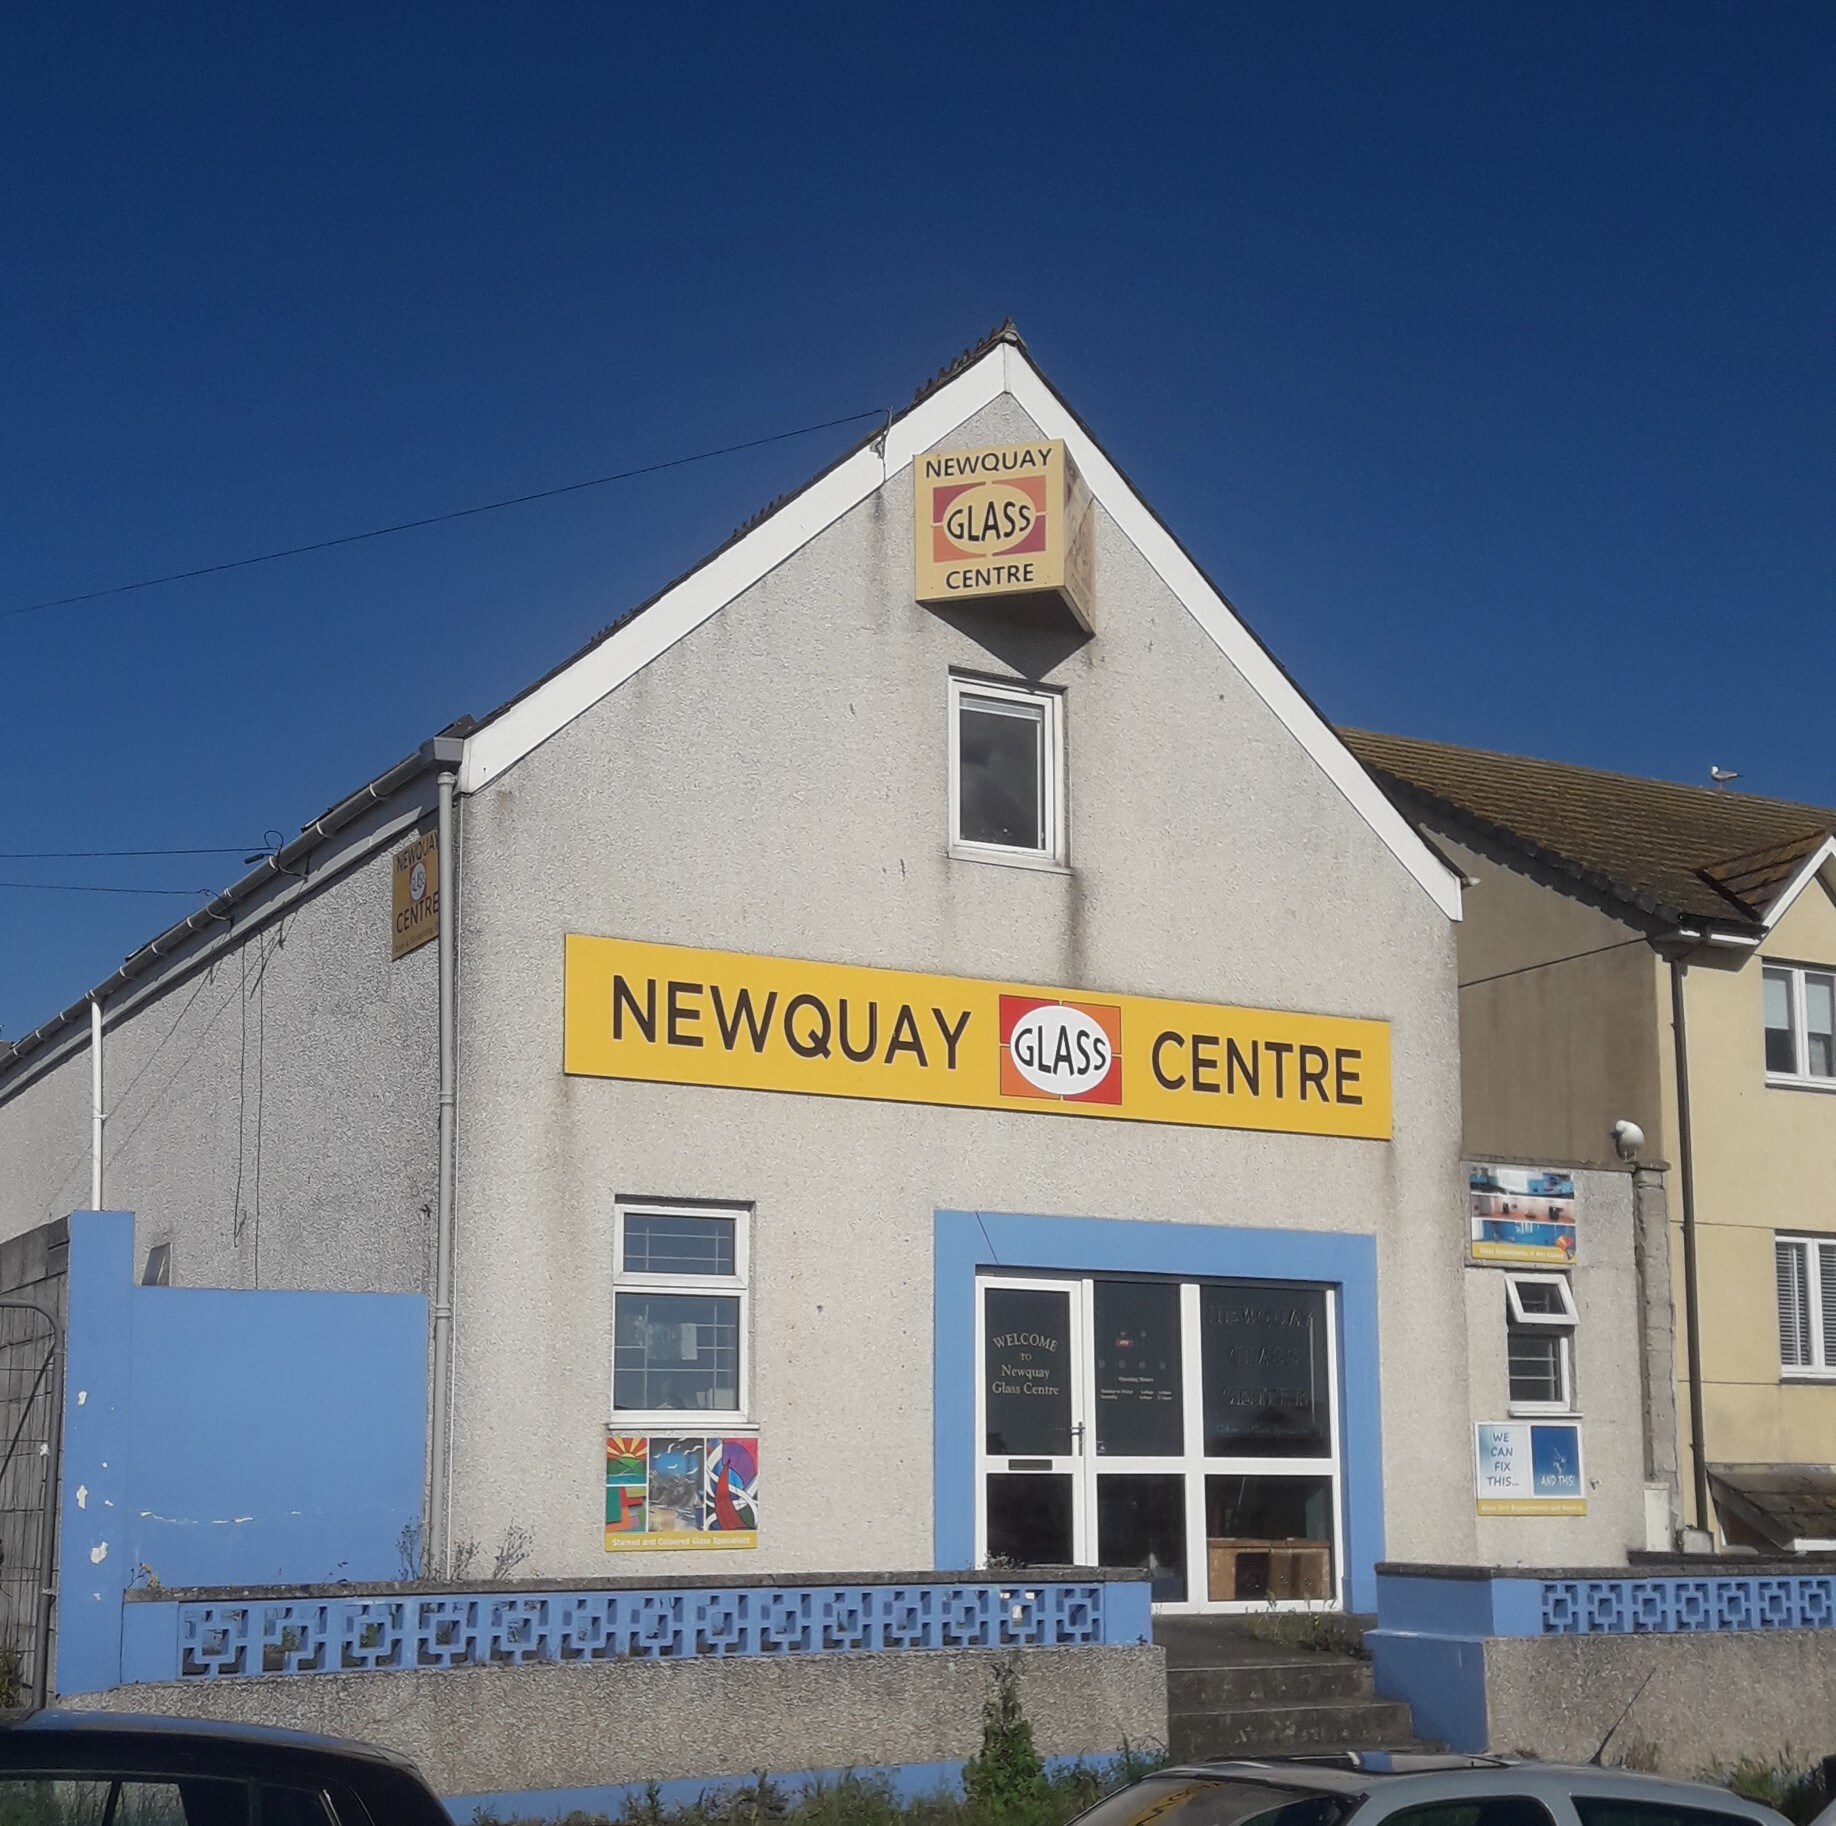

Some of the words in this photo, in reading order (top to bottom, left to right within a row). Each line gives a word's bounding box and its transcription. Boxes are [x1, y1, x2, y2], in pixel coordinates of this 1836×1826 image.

[926, 448, 1052, 479] NEWQUAY
[947, 501, 1031, 542] GLASS
[946, 563, 1034, 590] CENTRE
[396, 892, 439, 934] CENTRE
[613, 974, 972, 1070] NEWQUAY
[1014, 1025, 1107, 1077] GLASS
[1152, 1031, 1363, 1105] CENTRE
[992, 1333, 1058, 1352] WELCOME
[1020, 1352, 1032, 1361] TO
[1001, 1364, 1051, 1380] Newquay
[992, 1381, 1021, 1394] Glass
[1023, 1382, 1060, 1395] Centre
[1492, 1432, 1510, 1443] WE
[1490, 1446, 1513, 1457] CAN
[1494, 1461, 1511, 1472] FIX
[1541, 1475, 1556, 1486] AND
[612, 1538, 641, 1547] Stained
[642, 1537, 656, 1546] and
[691, 1536, 711, 1545] Glass
